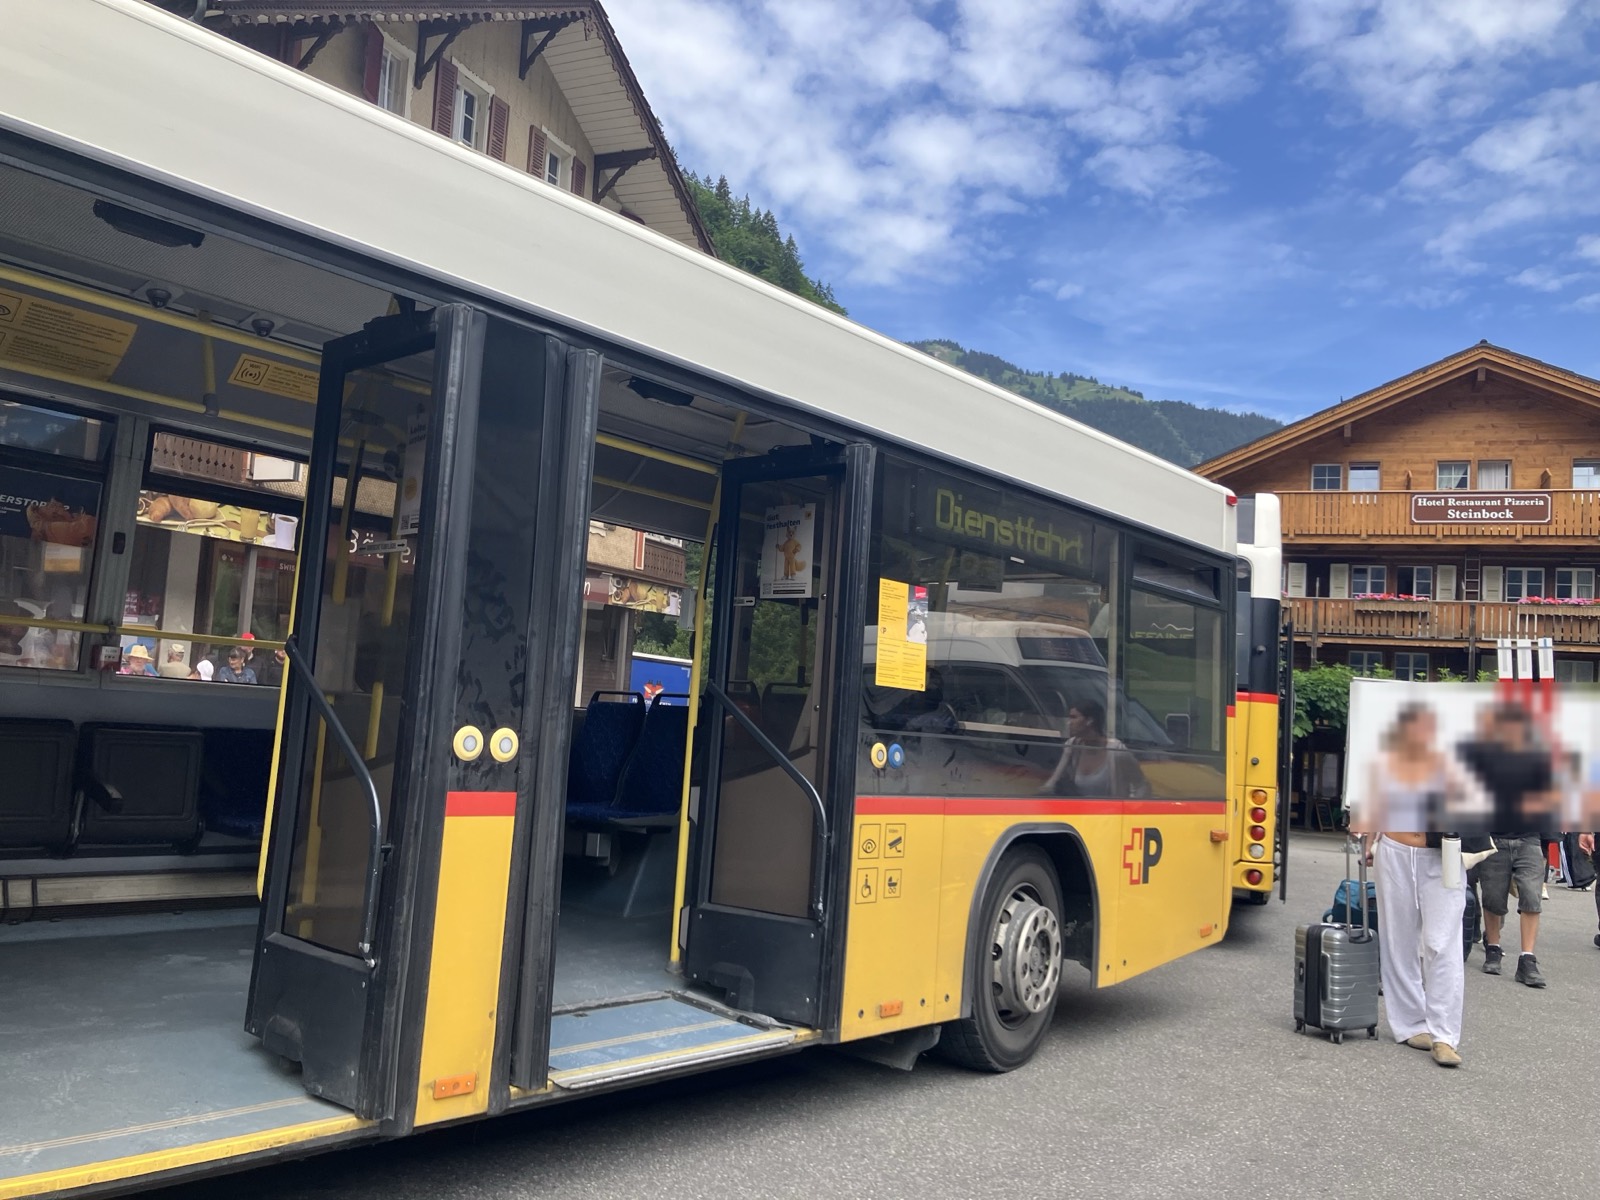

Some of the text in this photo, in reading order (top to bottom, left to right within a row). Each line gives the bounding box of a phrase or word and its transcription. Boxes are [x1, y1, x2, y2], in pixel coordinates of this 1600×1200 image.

[1417, 497, 1544, 507] Hotel Restaurant Pizzeria
[1447, 508, 1514, 519] Steinbock
[935, 488, 1083, 564] Dienstfahrt
[279, 562, 296, 572] SWIS
